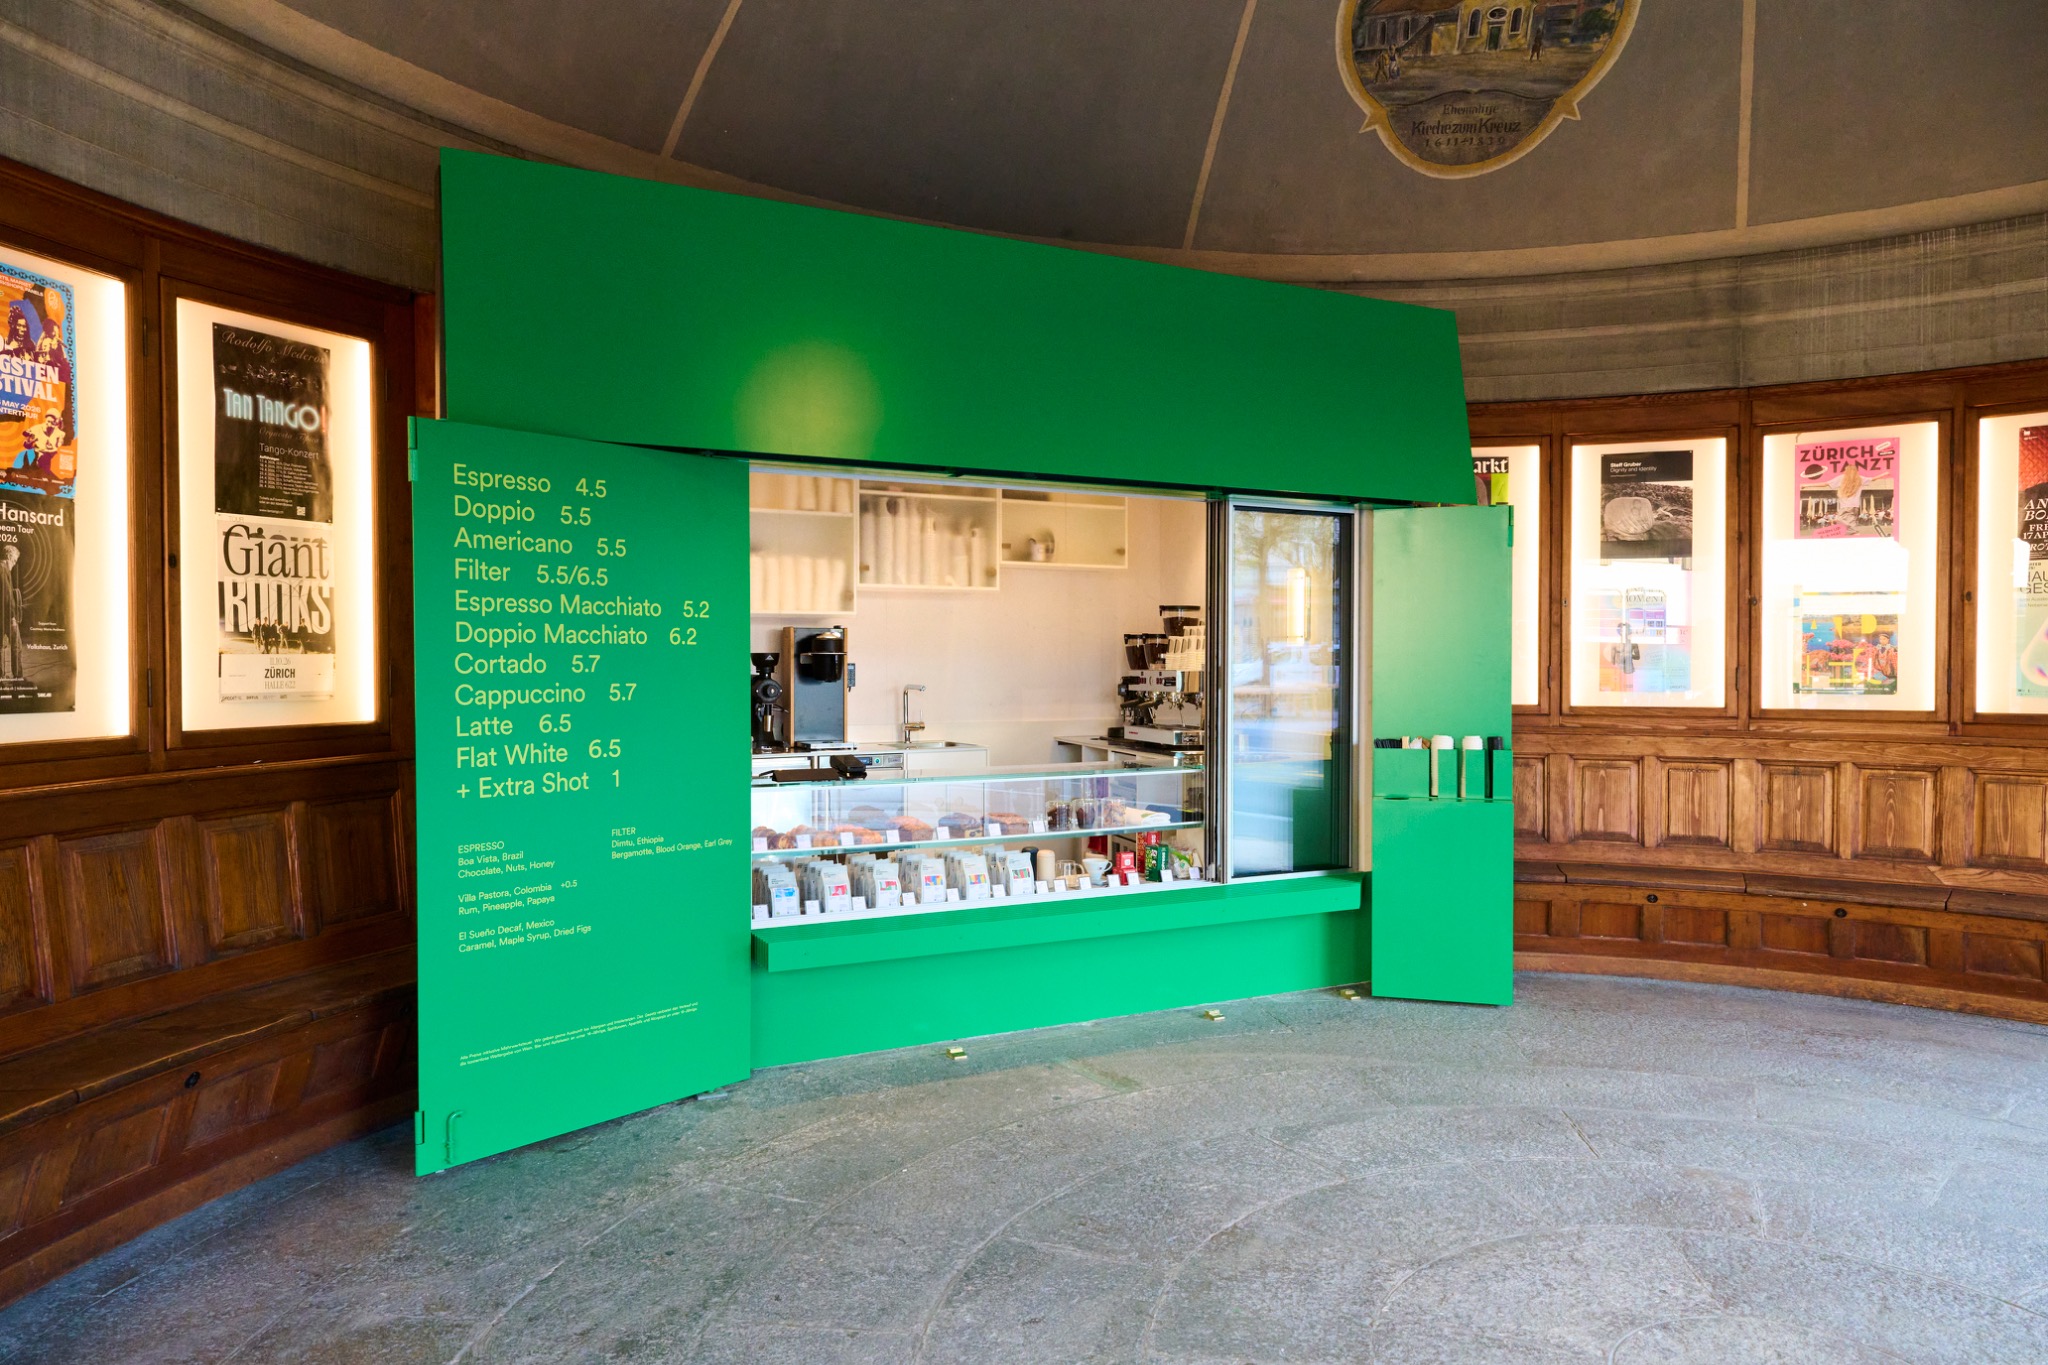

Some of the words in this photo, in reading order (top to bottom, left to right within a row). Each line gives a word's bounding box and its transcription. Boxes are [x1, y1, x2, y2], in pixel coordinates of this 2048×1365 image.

[1411, 120, 1452, 136] Kirche
[1452, 123, 1477, 134] zum
[1478, 118, 1522, 133] Kreuz
[222, 331, 272, 354] Rodolfo
[0, 354, 59, 384] GSTEN
[2, 400, 19, 409] MAY
[20, 404, 41, 414] 2026
[223, 388, 253, 421] TAN
[259, 442, 320, 460] Tango-Konzert
[1800, 445, 1874, 463] ZÜRICH
[1473, 458, 1509, 474] arkt
[453, 463, 552, 493] Espresso
[575, 477, 607, 498] 4.5
[0, 503, 64, 527] Hansard
[453, 495, 536, 524] Doppio
[559, 506, 592, 526] 5.5
[17, 525, 35, 534] Tour
[2023, 532, 2033, 540] 17
[223, 524, 330, 580] Giant
[453, 527, 574, 555] Americano
[596, 537, 627, 557] 5.5
[454, 558, 511, 582] Filter
[536, 565, 609, 587] 5.5/6.5
[223, 577, 331, 635] ROOKS
[454, 590, 553, 617] Espresso
[559, 593, 662, 618] Macchiato
[682, 599, 710, 619] 5.2
[455, 621, 537, 648] Doppio
[543, 623, 648, 645] Macchiato
[669, 627, 698, 646] 6.2
[264, 666, 296, 679] ZÜRICH
[454, 653, 547, 675] Cortado
[571, 654, 601, 674] 5.7
[454, 683, 586, 710] Cappuccino
[608, 682, 638, 702] 5.7
[455, 715, 514, 738] Latte
[538, 714, 572, 734] 6.5
[456, 746, 498, 769] Flat
[503, 742, 569, 766] White
[588, 738, 622, 759] 6.5
[456, 783, 471, 799] +
[479, 776, 535, 799] Extra
[541, 771, 590, 794] Shot
[611, 768, 620, 788] 1
[611, 827, 636, 837] FILTER
[611, 839, 635, 849] Dimtu,
[637, 835, 664, 846] Ethiopia
[458, 841, 505, 854] ESPRESSO
[458, 856, 474, 867] Boa
[475, 853, 500, 866] Vista,
[502, 850, 524, 862] Brazil
[611, 848, 655, 860] Bergamotte,
[656, 844, 675, 854] Blood
[676, 842, 703, 852] Orange,
[704, 839, 716, 848] Earl
[717, 837, 733, 847] Grey
[458, 864, 503, 879] Chocolate,
[505, 862, 527, 874] Nuts,
[529, 859, 556, 872] Honey
[457, 893, 476, 903] Villa
[478, 890, 512, 901] Pastora,
[513, 883, 552, 896] Colombia
[560, 879, 578, 889] +0.5
[458, 906, 480, 916] Rum,
[482, 899, 525, 912] Pineapple,
[526, 895, 555, 906] Papaya
[458, 932, 467, 941] El
[468, 928, 496, 939] Sueño
[497, 923, 524, 935] Decaf,
[525, 919, 555, 930] Mexico
[458, 940, 497, 953] Caramel,
[498, 935, 525, 947] Maple
[526, 931, 552, 943] Syrup,
[553, 926, 575, 938] Dried
[576, 924, 592, 935] Figs
